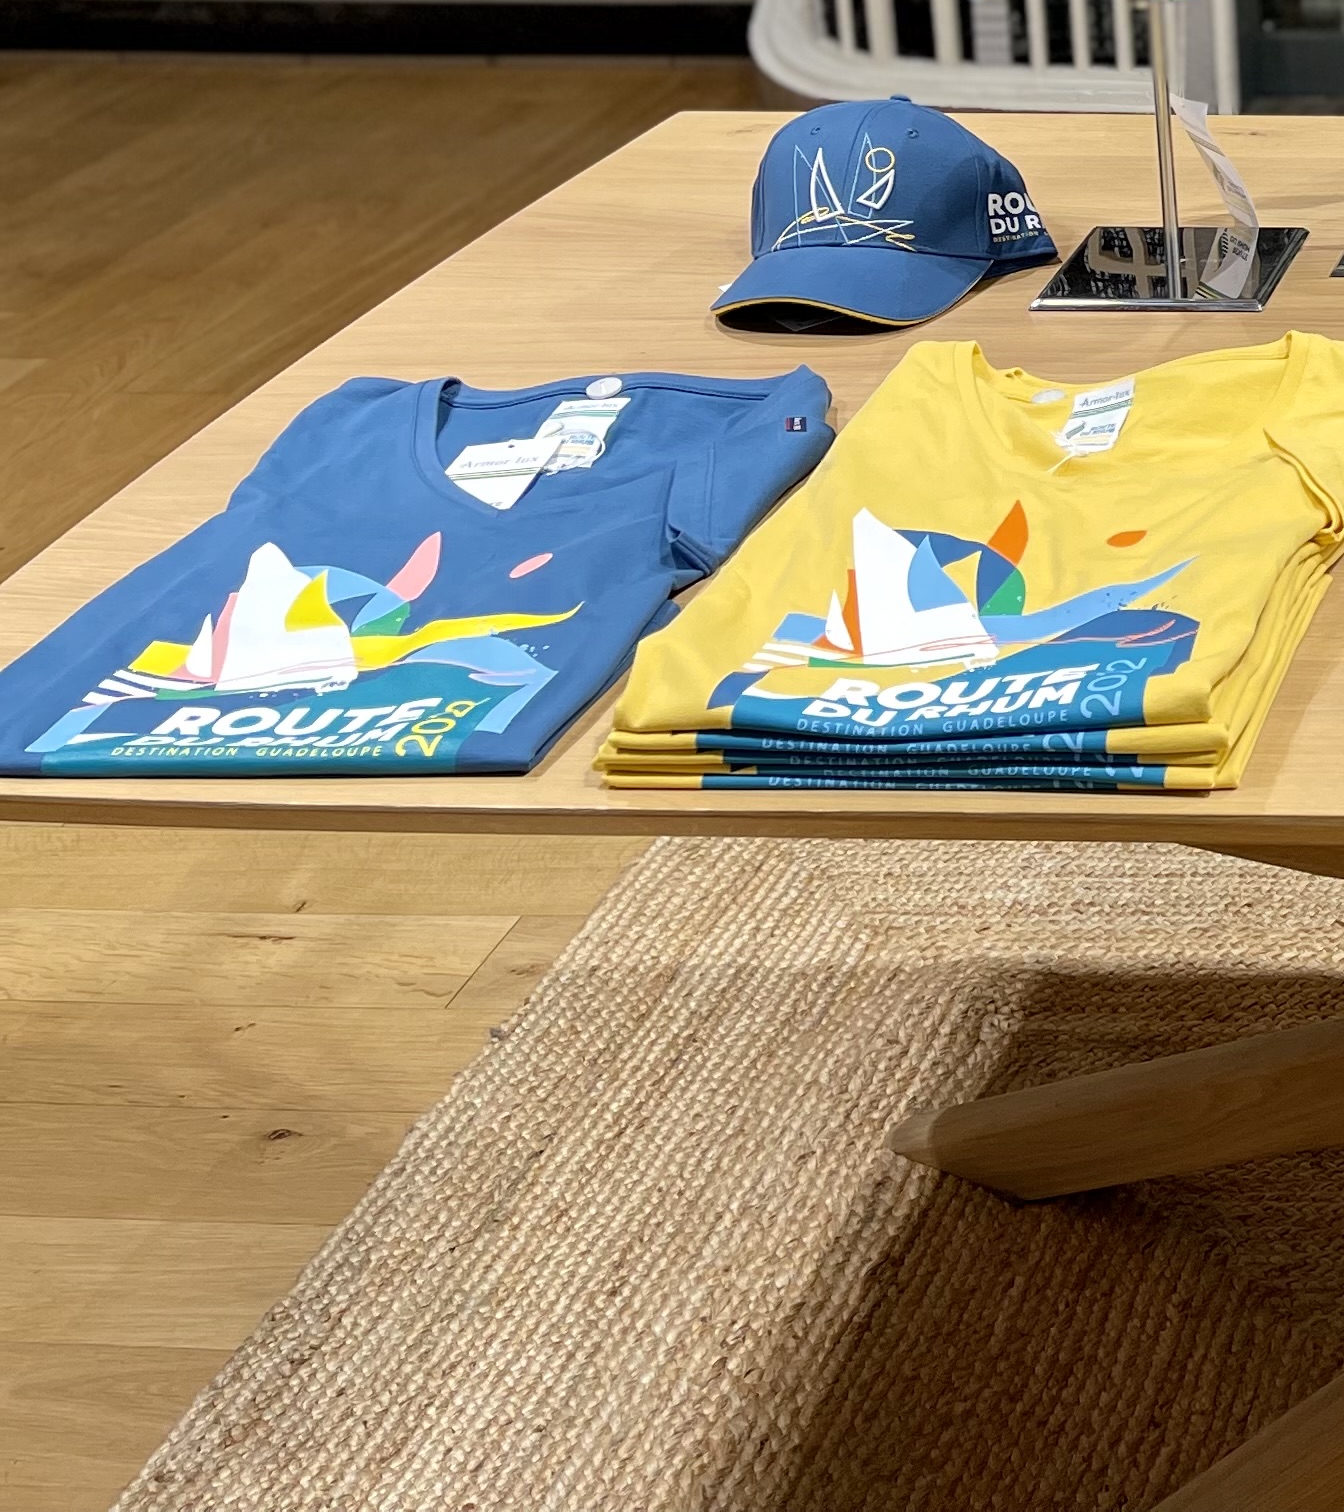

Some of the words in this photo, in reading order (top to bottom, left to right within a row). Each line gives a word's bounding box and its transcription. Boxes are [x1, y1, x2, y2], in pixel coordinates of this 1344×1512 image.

[988, 191, 1038, 216] ROU
[990, 216, 1020, 234] DU
[821, 663, 1100, 710] ROUTE
[150, 697, 443, 736] ROUTE
[802, 699, 899, 727] DU
[904, 681, 1081, 722] RHUM
[796, 718, 924, 737] DESTINATION
[942, 709, 1068, 734] GUADELOUPE
[111, 747, 239, 757] DESTINATION
[255, 744, 382, 757] GUADELOUPE
